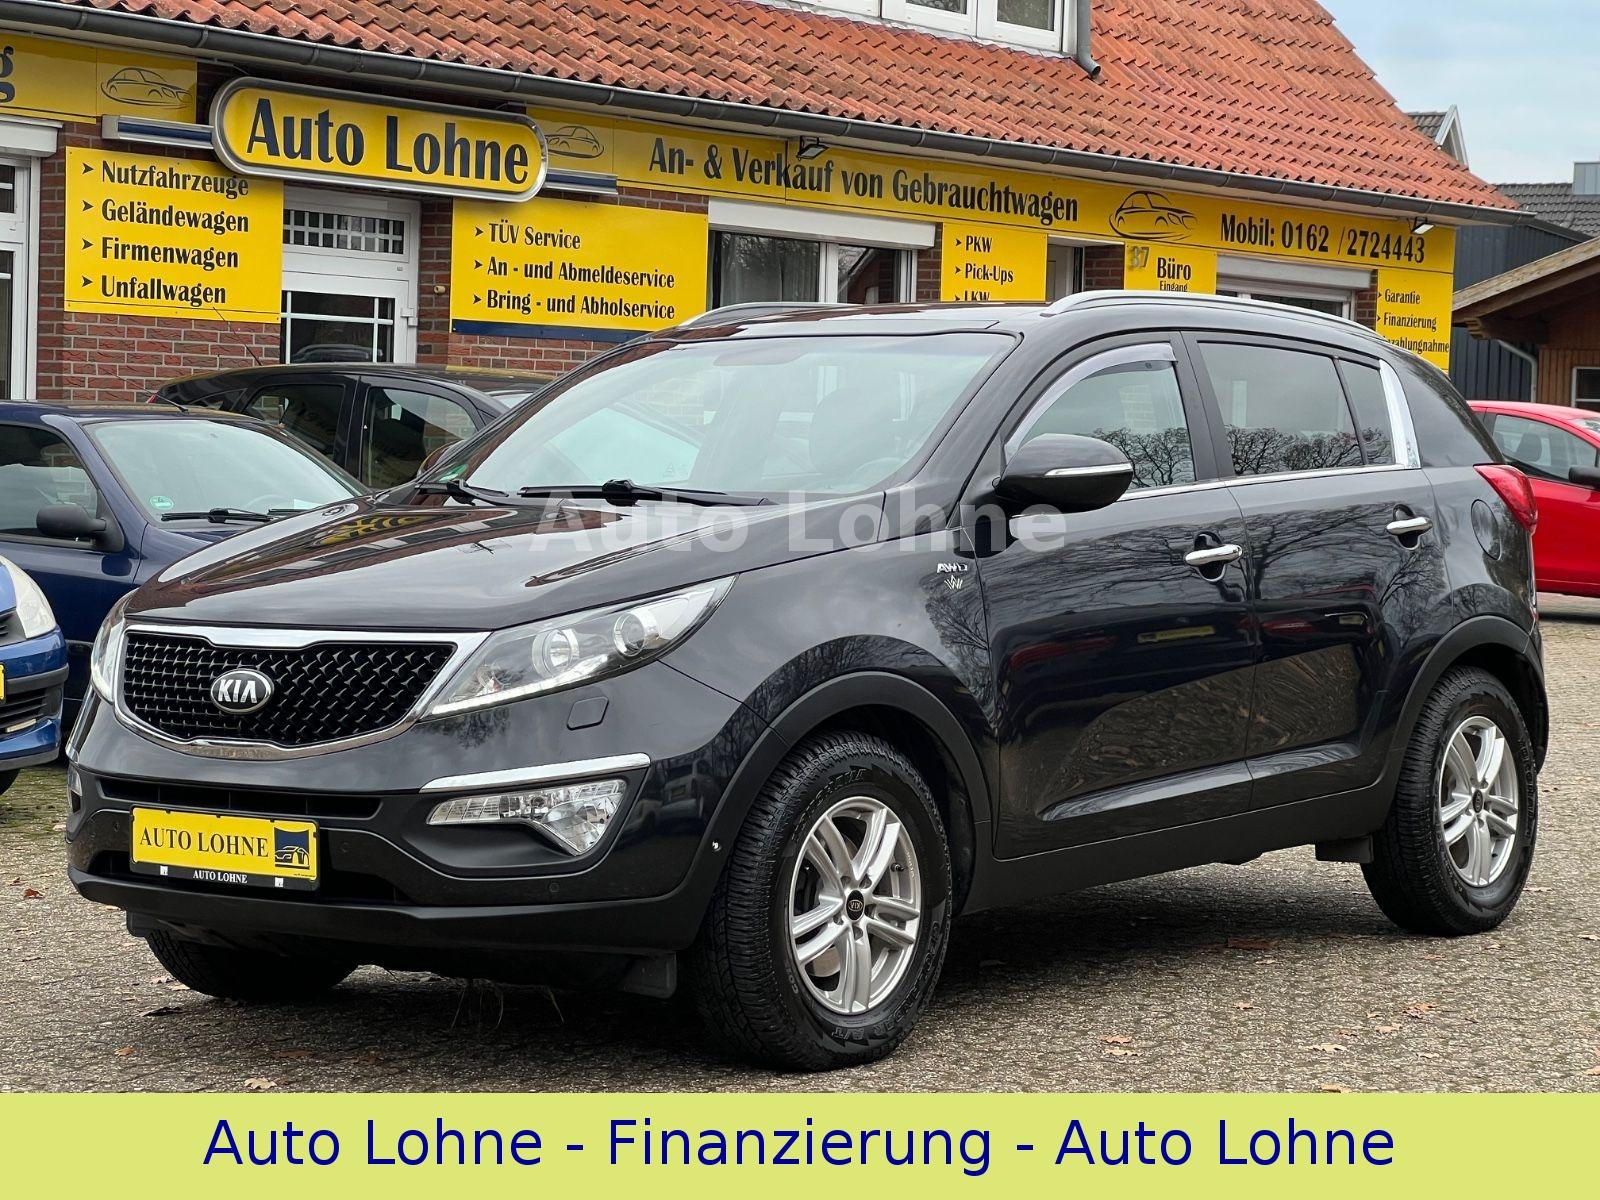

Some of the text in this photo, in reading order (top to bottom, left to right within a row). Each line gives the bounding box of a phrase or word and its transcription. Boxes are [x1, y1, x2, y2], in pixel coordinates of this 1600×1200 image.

[247, 98, 529, 184] Auto Lohne
[102, 160, 249, 199] Nutzfahrzeuge
[649, 137, 1078, 226] An- & Verkauf von Gebrauchtwagen
[101, 198, 249, 236] Geländewagen
[488, 219, 581, 250] TÜV Service
[965, 235, 992, 254] PKW
[1220, 213, 1276, 247] Mobil:
[1281, 221, 1330, 253] 0162
[101, 236, 239, 271] Firmenwagen
[1157, 256, 1192, 281] Büro
[487, 256, 508, 277] An
[524, 261, 554, 280] und
[558, 262, 675, 289] Abmeldeservice
[964, 263, 1014, 284] Pick-Ups
[1159, 280, 1188, 293] Eingang
[101, 274, 226, 308] Unfallwagen
[487, 289, 531, 315] Bring
[546, 295, 576, 314] und
[580, 296, 675, 320] Abholservice
[1384, 288, 1421, 305] Garantie
[1383, 311, 1437, 332] Finanzierung
[217, 680, 258, 704] KIA
[140, 827, 269, 858] AUTO LOHNE
[193, 870, 248, 884] AUTO LOHNE
